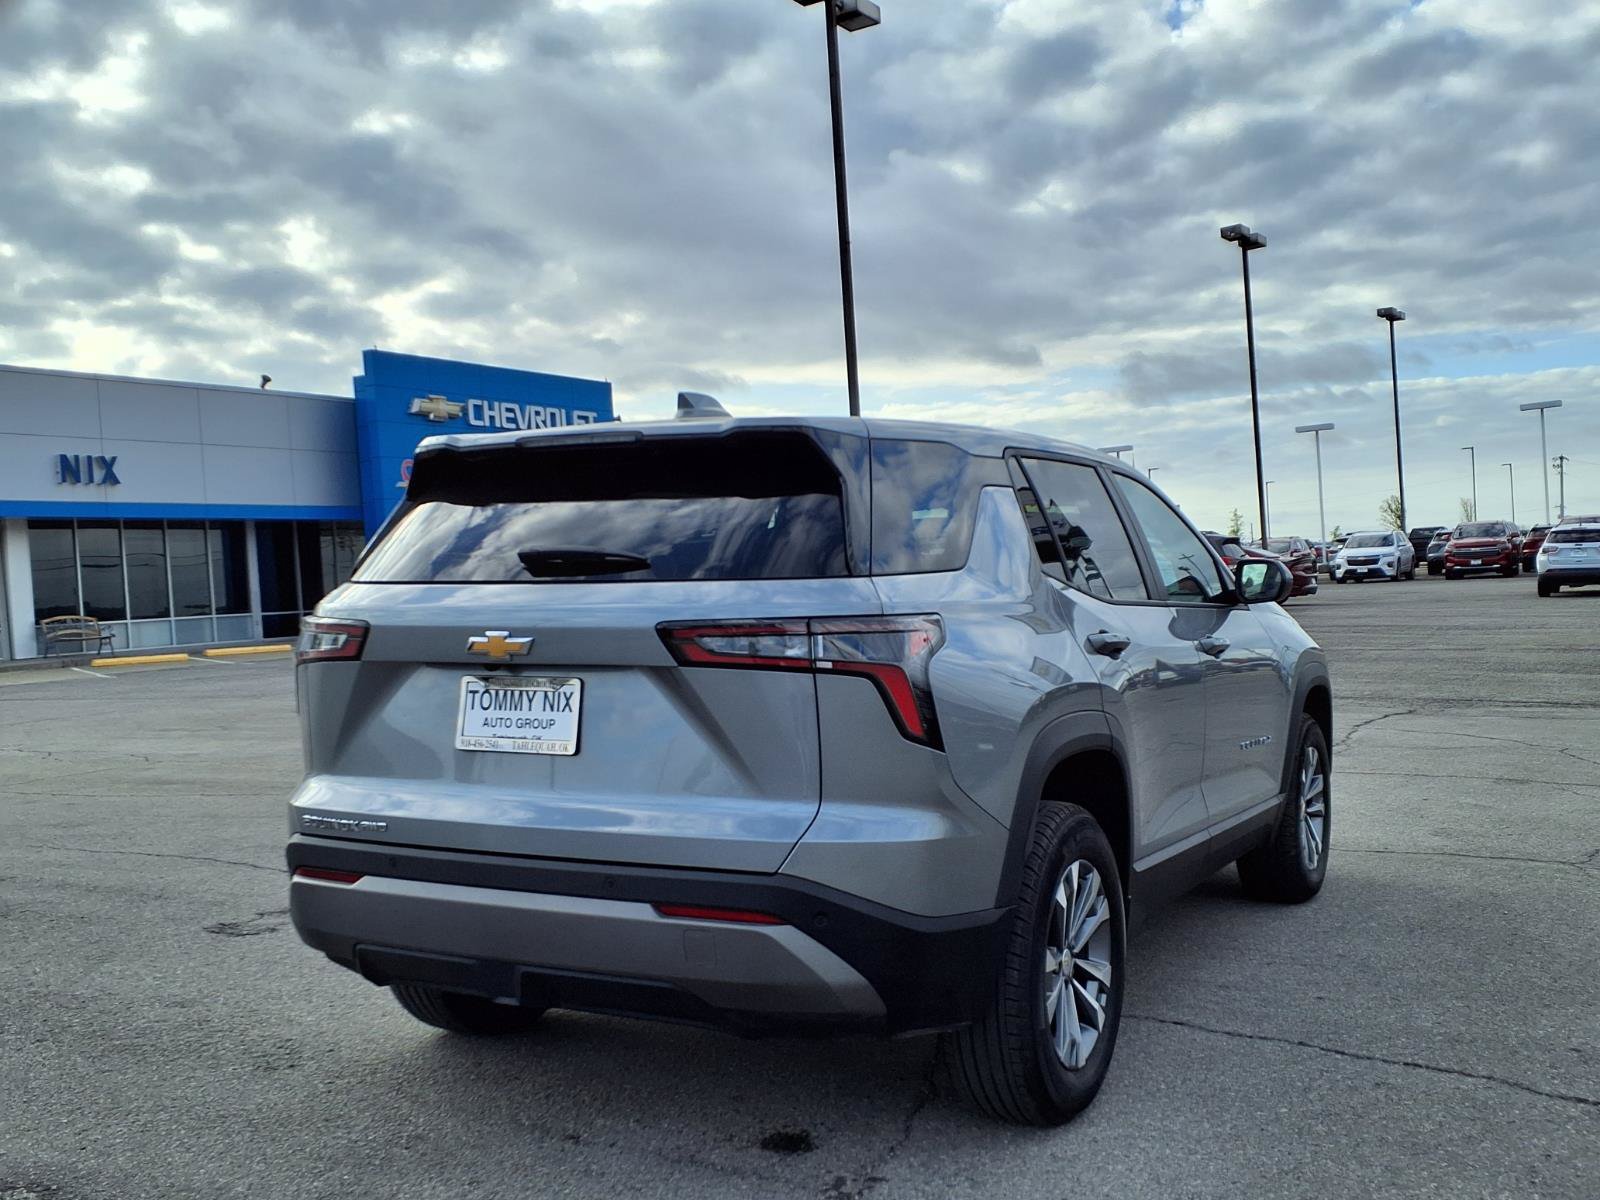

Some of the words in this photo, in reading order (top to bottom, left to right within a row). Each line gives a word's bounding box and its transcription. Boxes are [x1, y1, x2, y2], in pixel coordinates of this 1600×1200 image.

[467, 398, 598, 430] CHEVROLET
[58, 454, 121, 485] NIX
[468, 689, 537, 712] TOMMY
[542, 691, 574, 713] NIX
[482, 717, 514, 729] AUTO
[516, 718, 556, 730] GROUP
